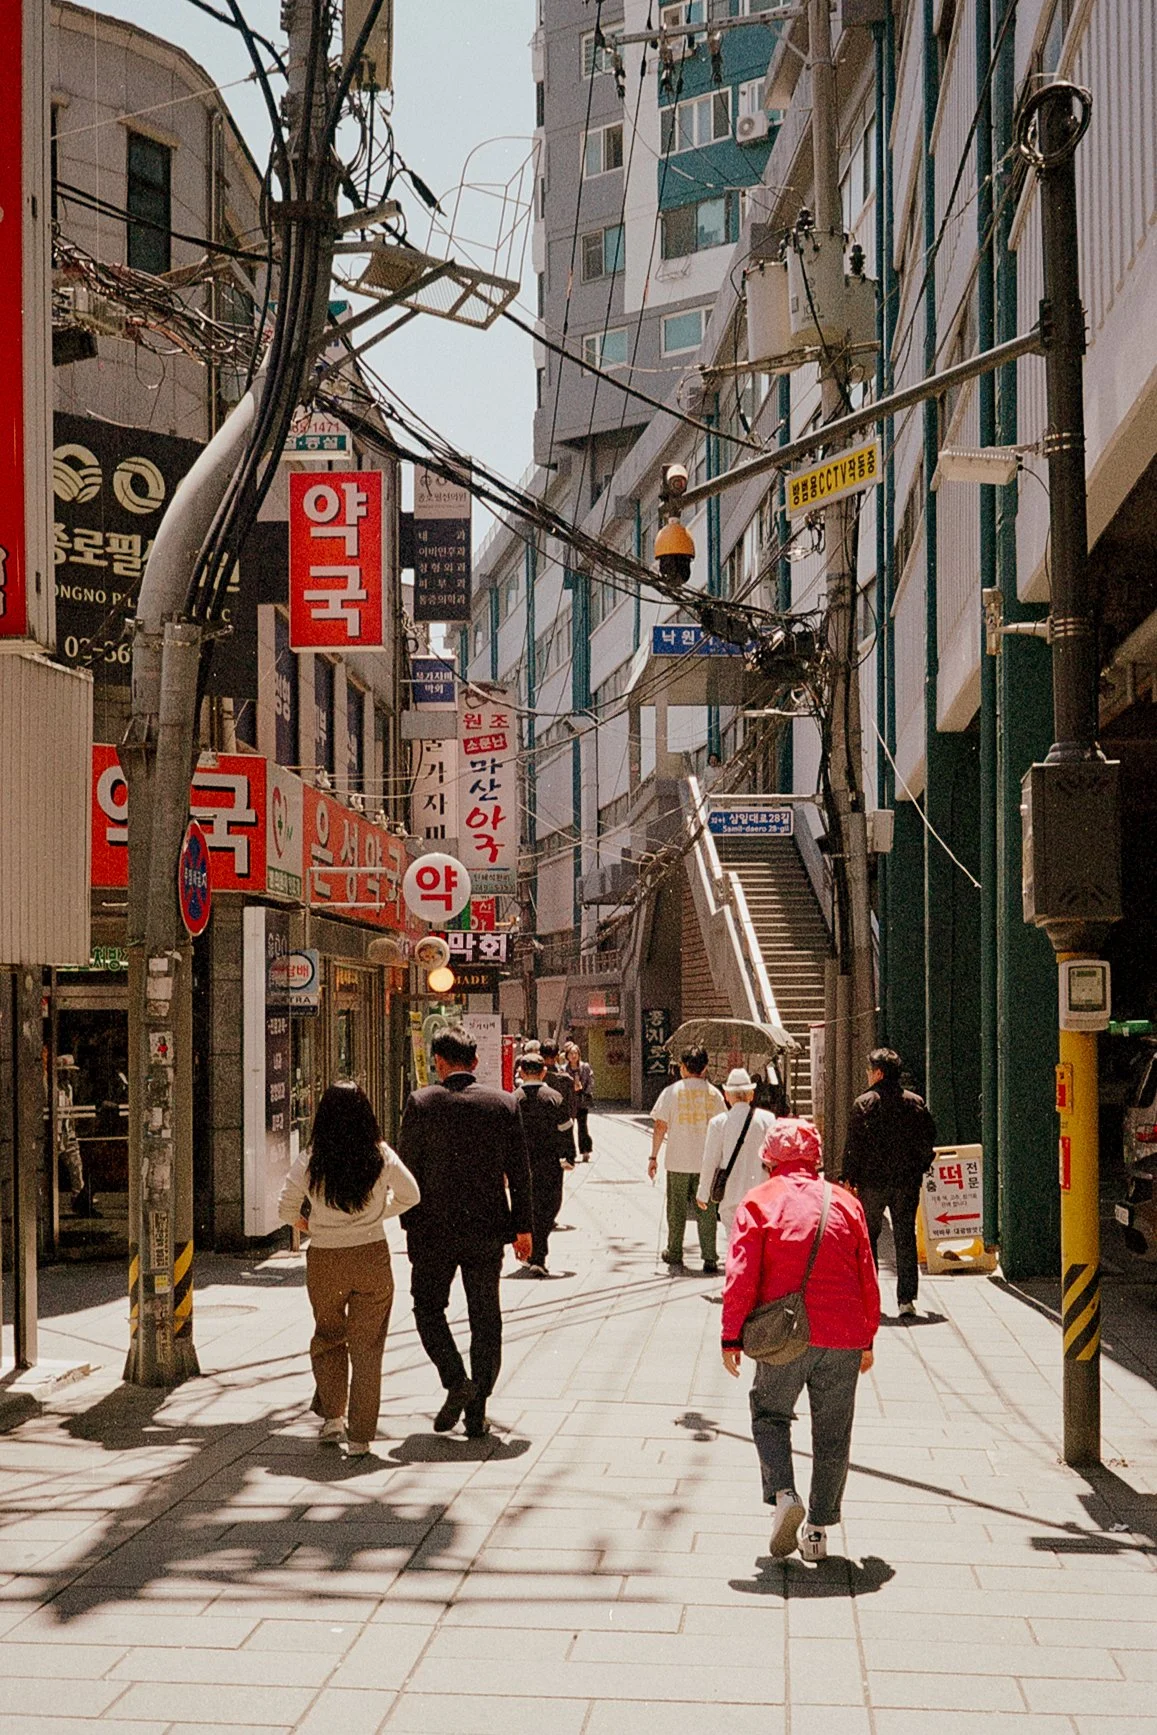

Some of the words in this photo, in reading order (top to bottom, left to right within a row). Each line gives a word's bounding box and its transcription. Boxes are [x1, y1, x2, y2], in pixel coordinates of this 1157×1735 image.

[792, 448, 875, 505] 방범용CCTV작동중
[303, 482, 367, 637] 약국
[722, 825, 767, 834] Samil-daero
[729, 813, 790, 825] 삼일대로28길
[416, 865, 458, 912] 약
[447, 933, 507, 962] 막회
[938, 1163, 964, 1190] 떡
